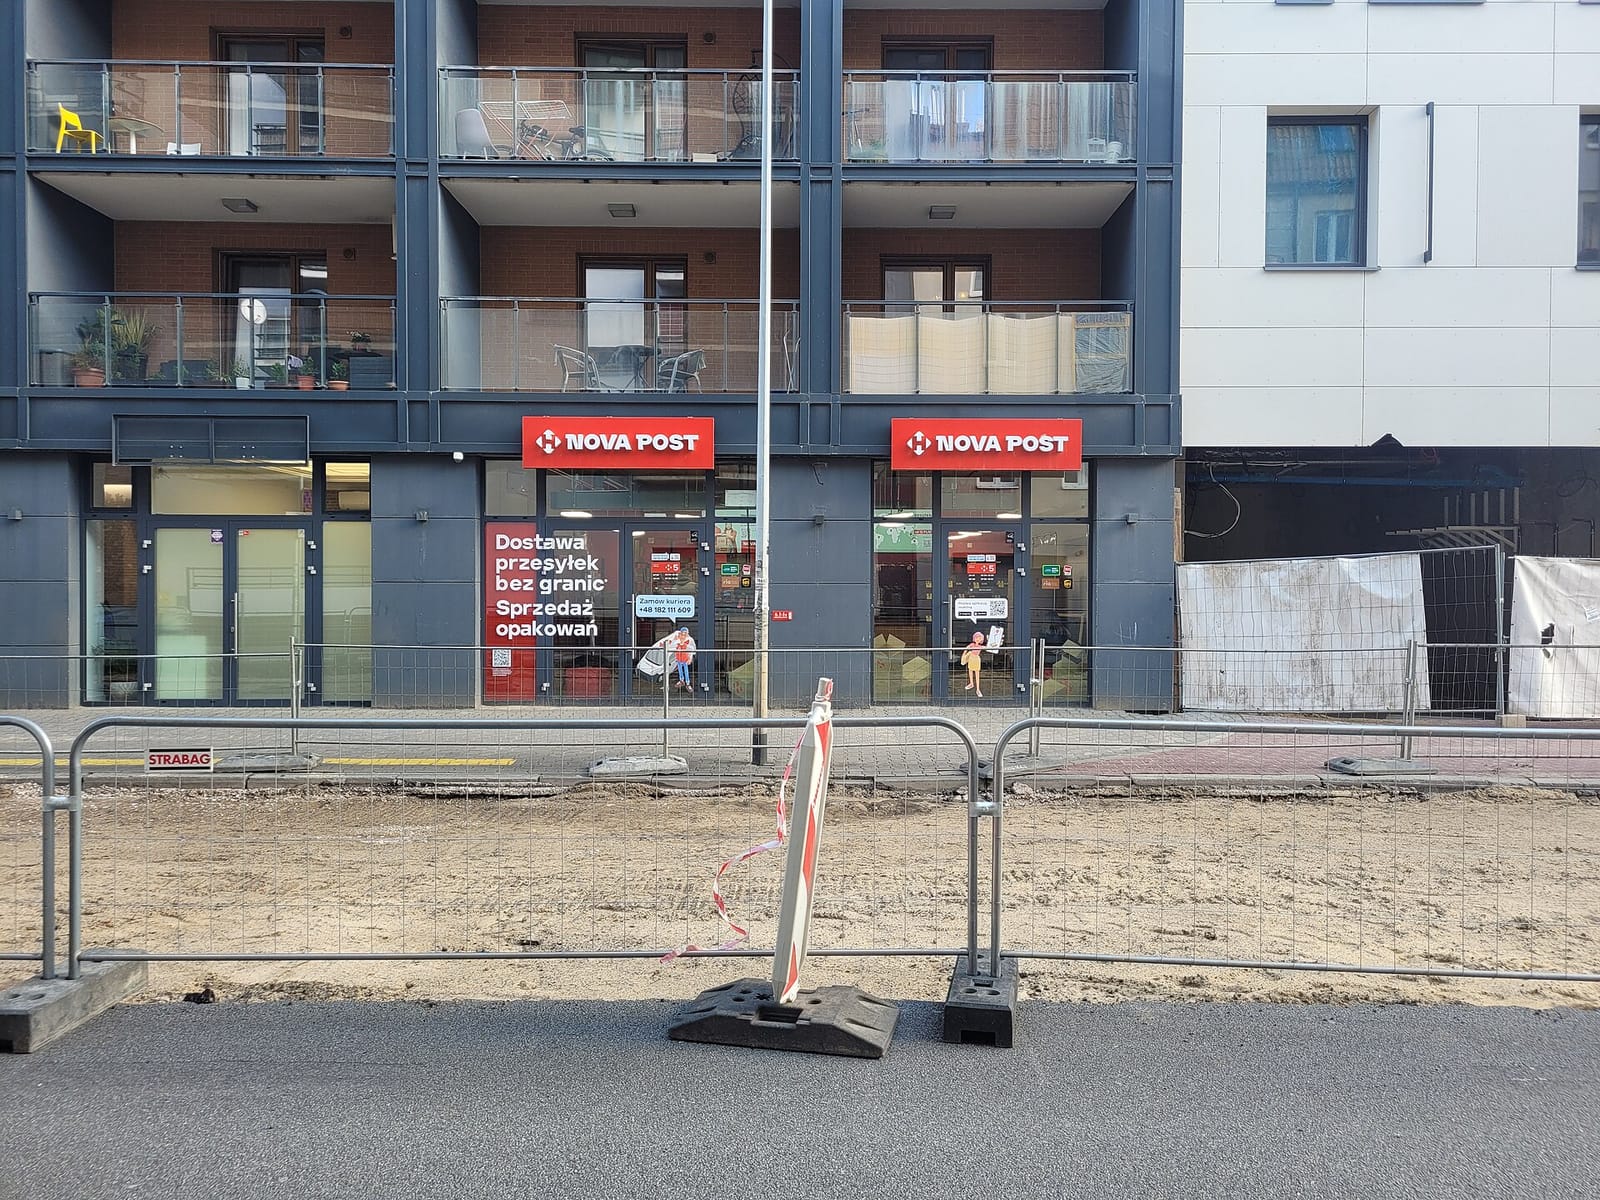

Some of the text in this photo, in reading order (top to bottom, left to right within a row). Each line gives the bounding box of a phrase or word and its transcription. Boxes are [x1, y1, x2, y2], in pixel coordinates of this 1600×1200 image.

[565, 433, 699, 451] NOVA POST
[936, 435, 1069, 452] NOVA POST
[495, 533, 585, 550] Dostawa
[495, 555, 599, 574] przesyłek
[495, 575, 534, 591] bez
[495, 599, 593, 619] Sprzedaż
[495, 620, 598, 639] opakowań
[149, 754, 211, 765] STRABAG
